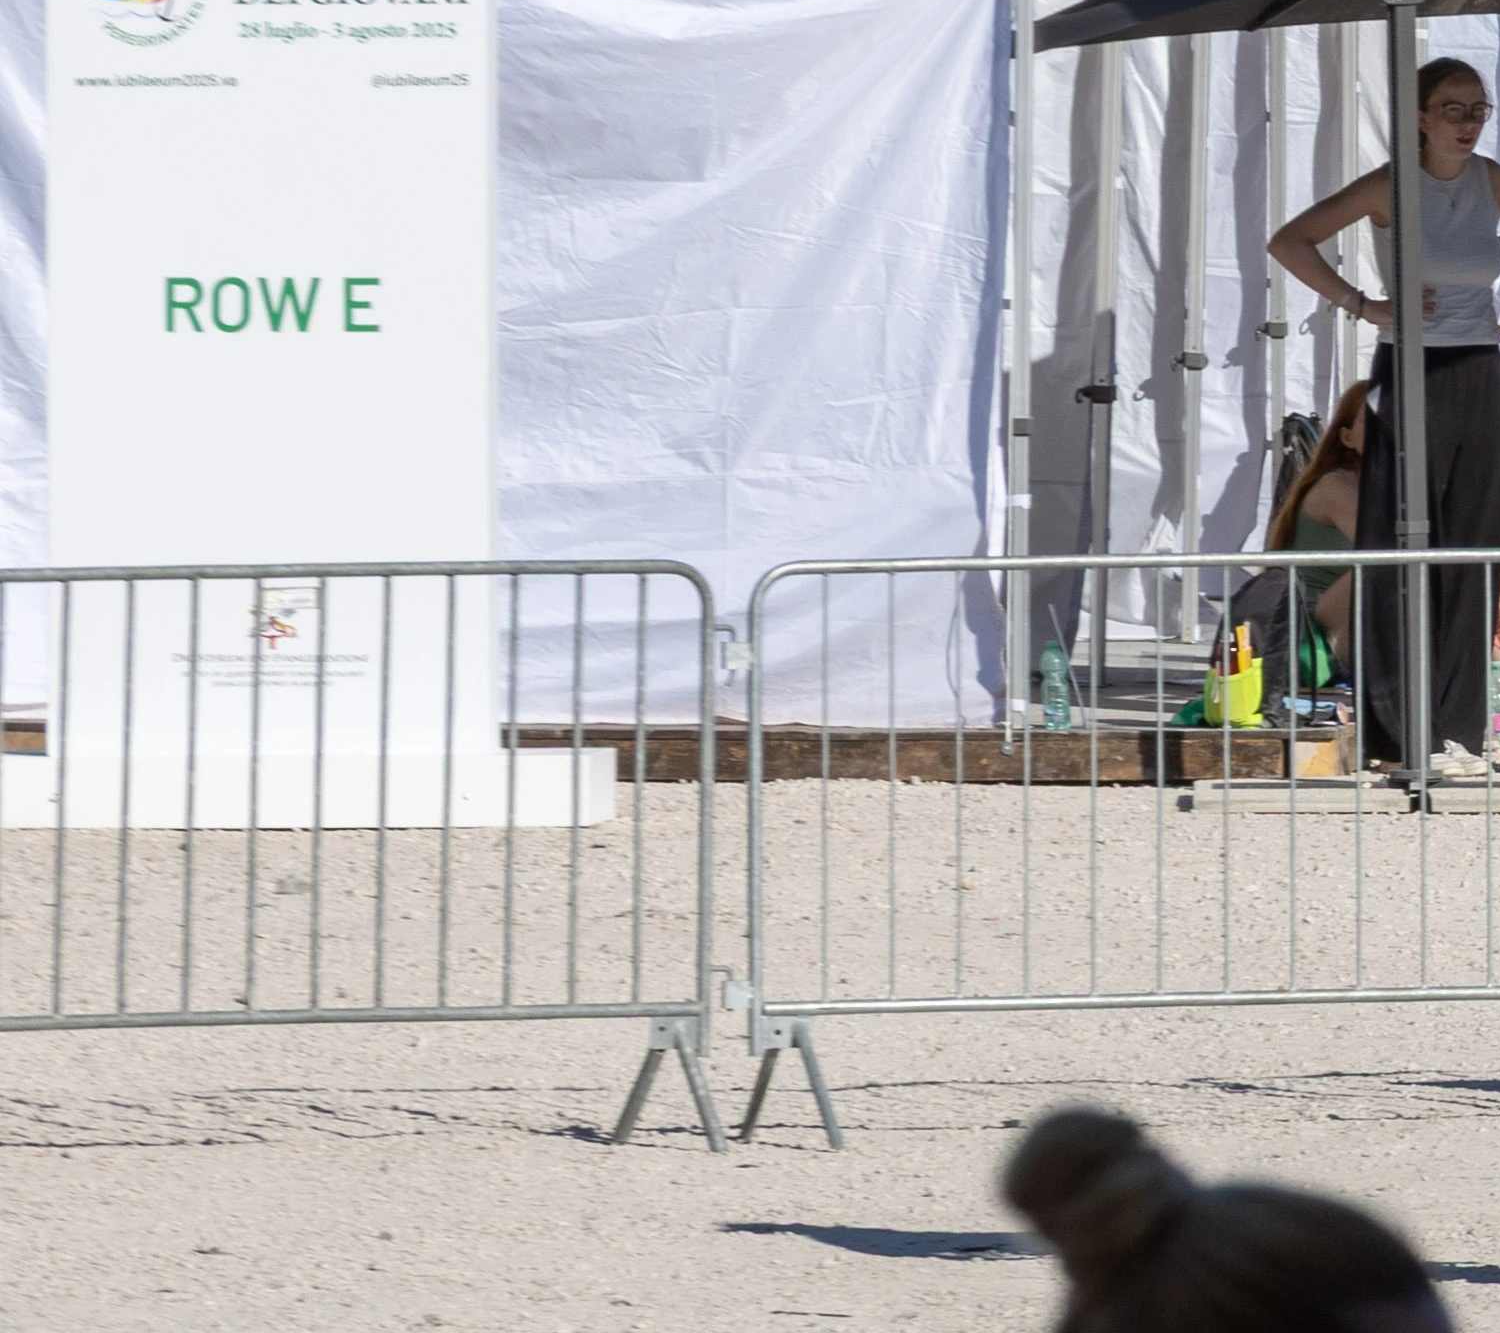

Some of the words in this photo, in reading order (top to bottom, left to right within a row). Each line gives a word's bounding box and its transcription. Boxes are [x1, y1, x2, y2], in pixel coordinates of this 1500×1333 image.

[238, 21, 263, 38] 28
[265, 21, 319, 44] luglio
[332, 21, 344, 38] 3
[347, 23, 408, 44] agosto
[410, 21, 458, 38] 2025
[165, 277, 321, 333] ROW
[344, 277, 380, 333] E
